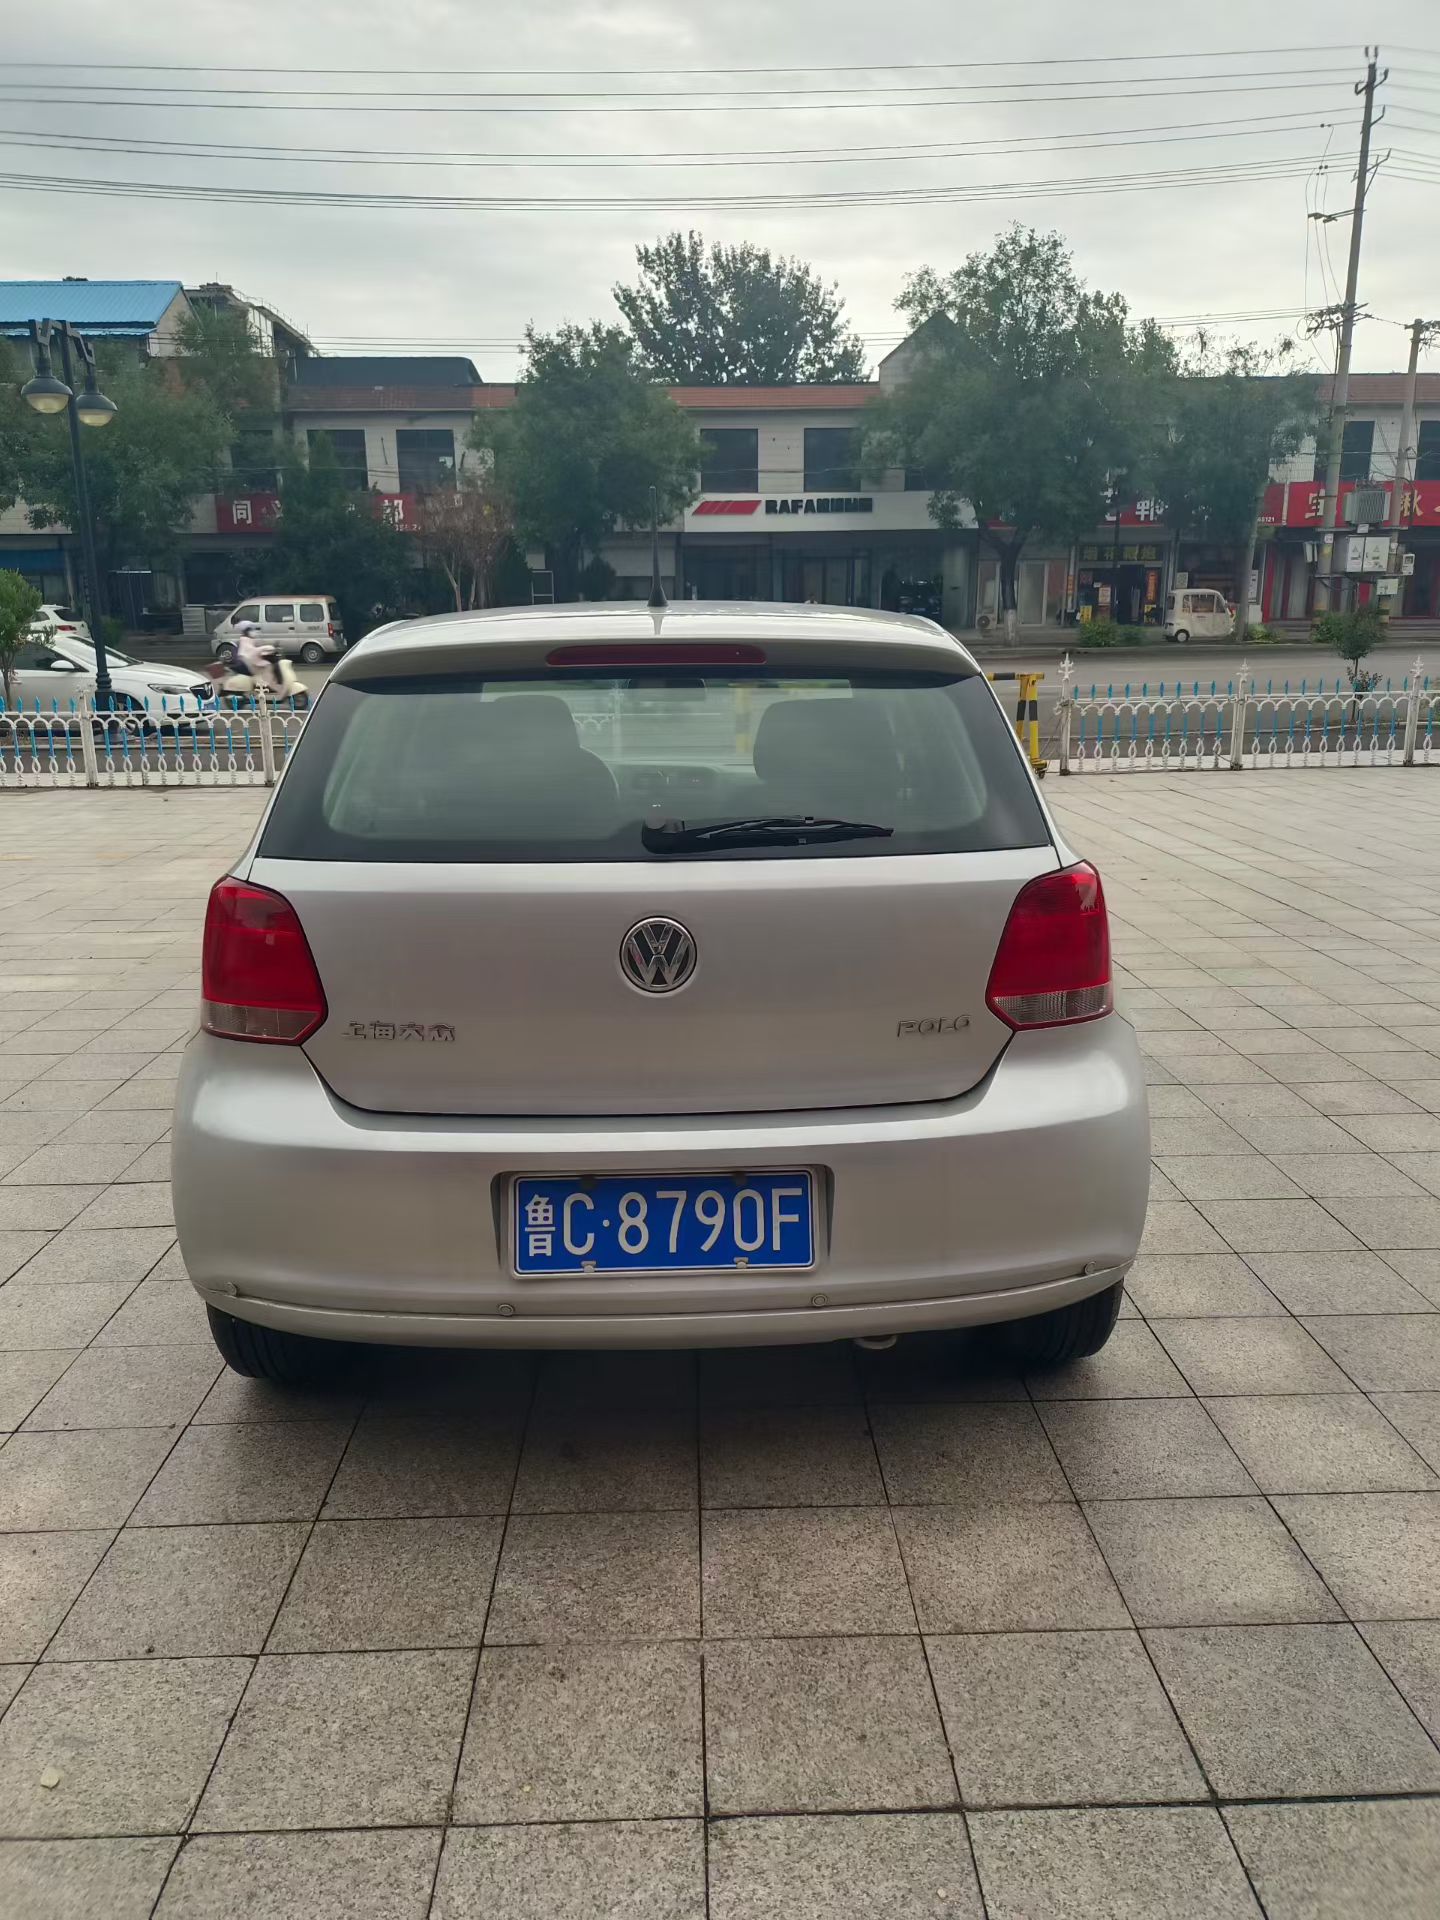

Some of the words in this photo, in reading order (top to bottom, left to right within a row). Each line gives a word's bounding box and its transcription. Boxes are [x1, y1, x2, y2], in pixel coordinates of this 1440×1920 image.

[341, 1020, 456, 1041] 上海大众
[897, 1014, 971, 1038] POLO
[524, 1187, 803, 1258] 鲁C·8790F
